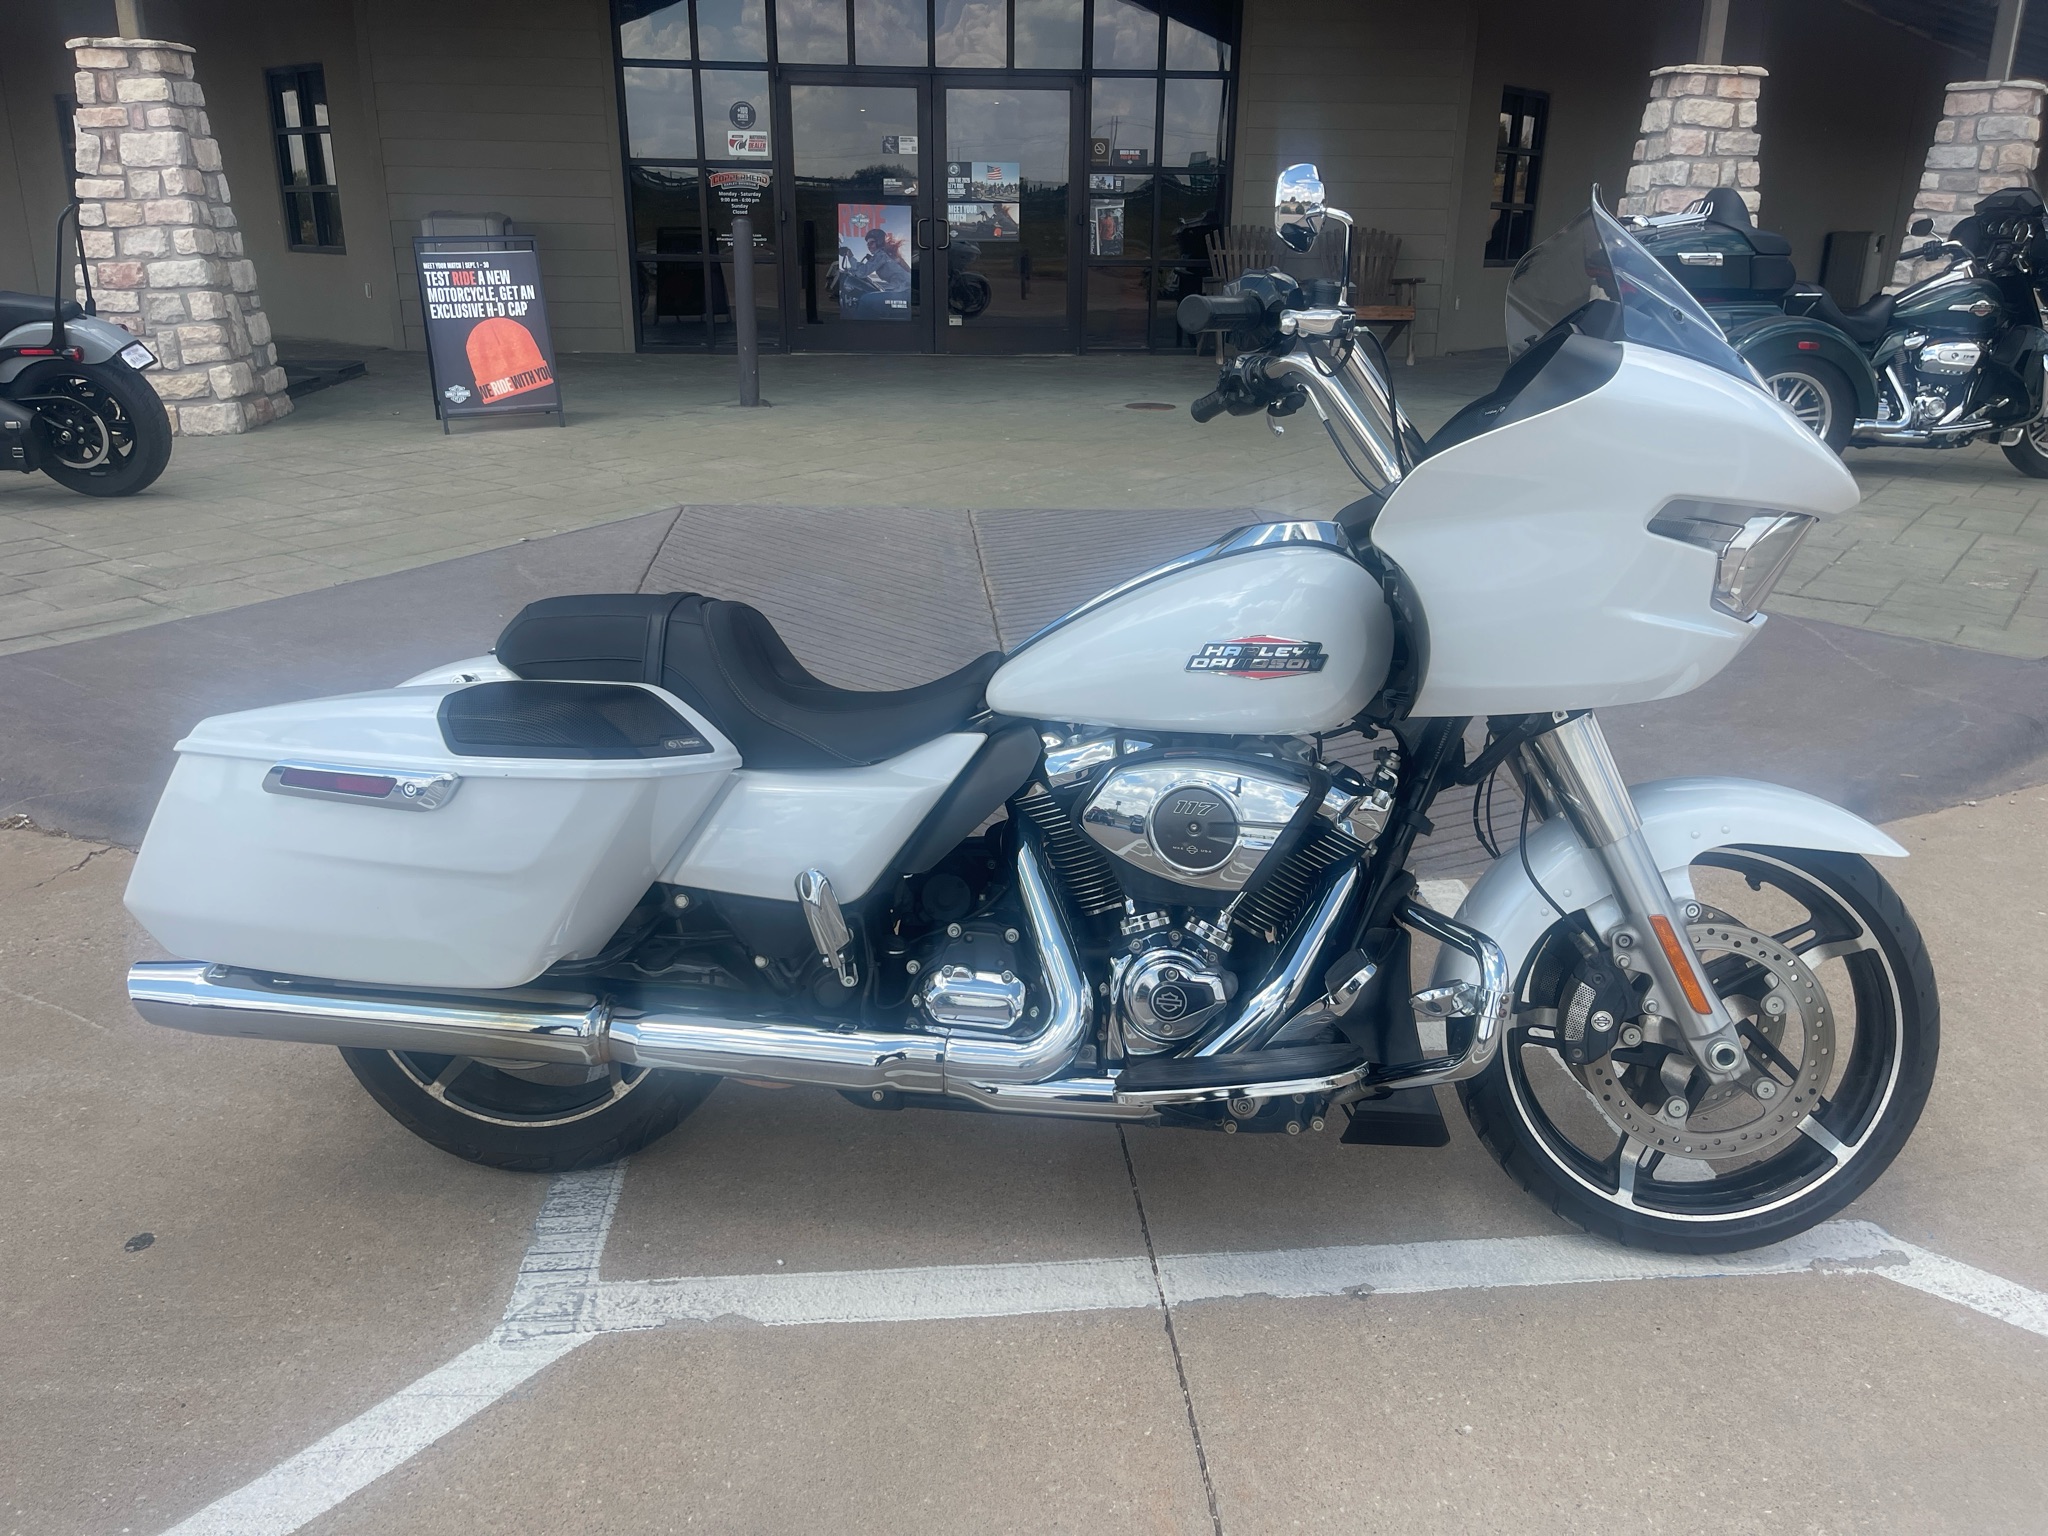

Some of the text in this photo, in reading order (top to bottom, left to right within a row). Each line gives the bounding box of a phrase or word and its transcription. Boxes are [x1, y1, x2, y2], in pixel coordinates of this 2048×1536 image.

[712, 172, 768, 184] COPPERHEAD
[948, 205, 977, 213] MEET YOUR
[948, 214, 966, 222] MATCH
[424, 270, 511, 286] TEST RIDE A NEW
[427, 285, 535, 302] MOTORCYCLE, GET AN
[430, 302, 486, 319] EXCLUSIVE
[490, 377, 514, 396] RIDE
[510, 370, 537, 389] WITH
[534, 365, 553, 382] YOU
[1204, 646, 1306, 656] HARLEY
[1190, 658, 1320, 669] DAVIDSON
[1174, 800, 1219, 816] 117
